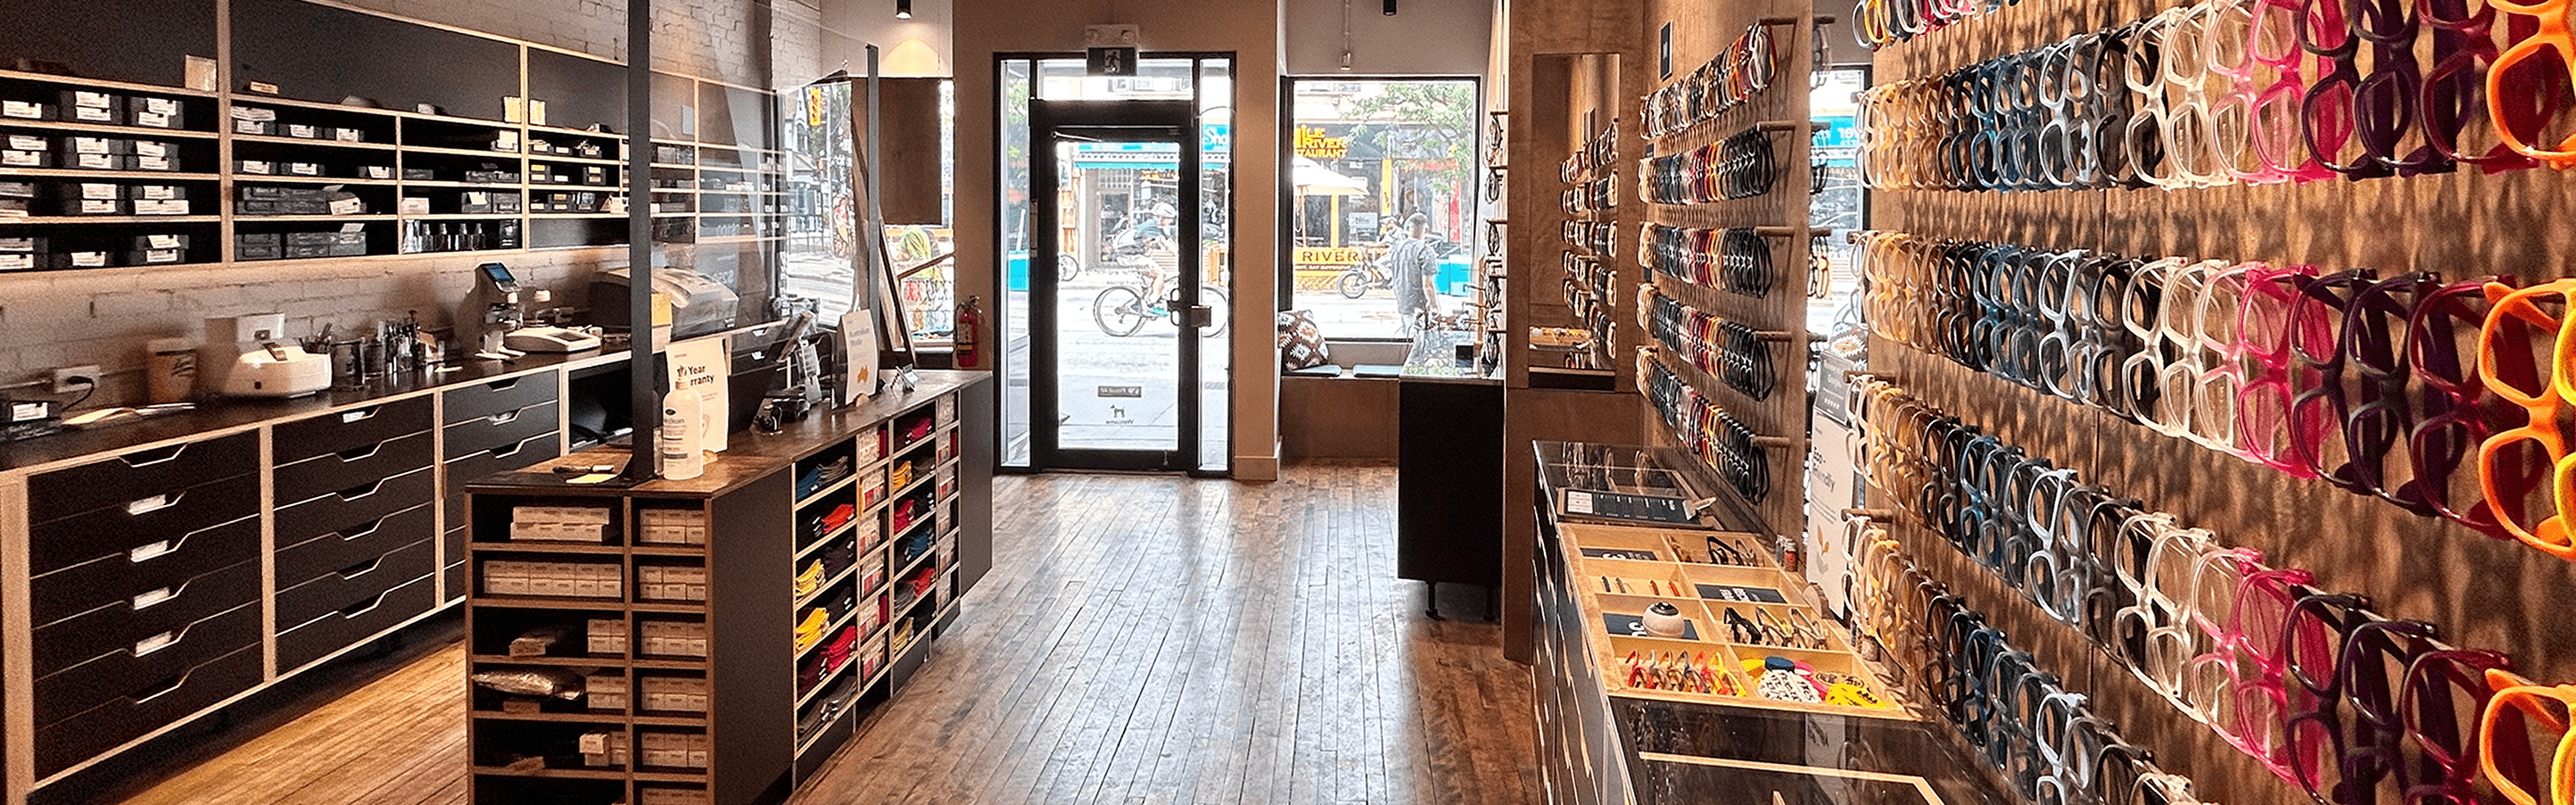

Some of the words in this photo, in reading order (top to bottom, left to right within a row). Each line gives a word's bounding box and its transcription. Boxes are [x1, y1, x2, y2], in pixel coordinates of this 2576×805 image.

[1304, 137, 1348, 148] RIVER
[1296, 148, 1348, 158] TAURANT
[1302, 251, 1361, 262] RIVER
[688, 366, 706, 375] Year
[689, 375, 714, 386] rranty
